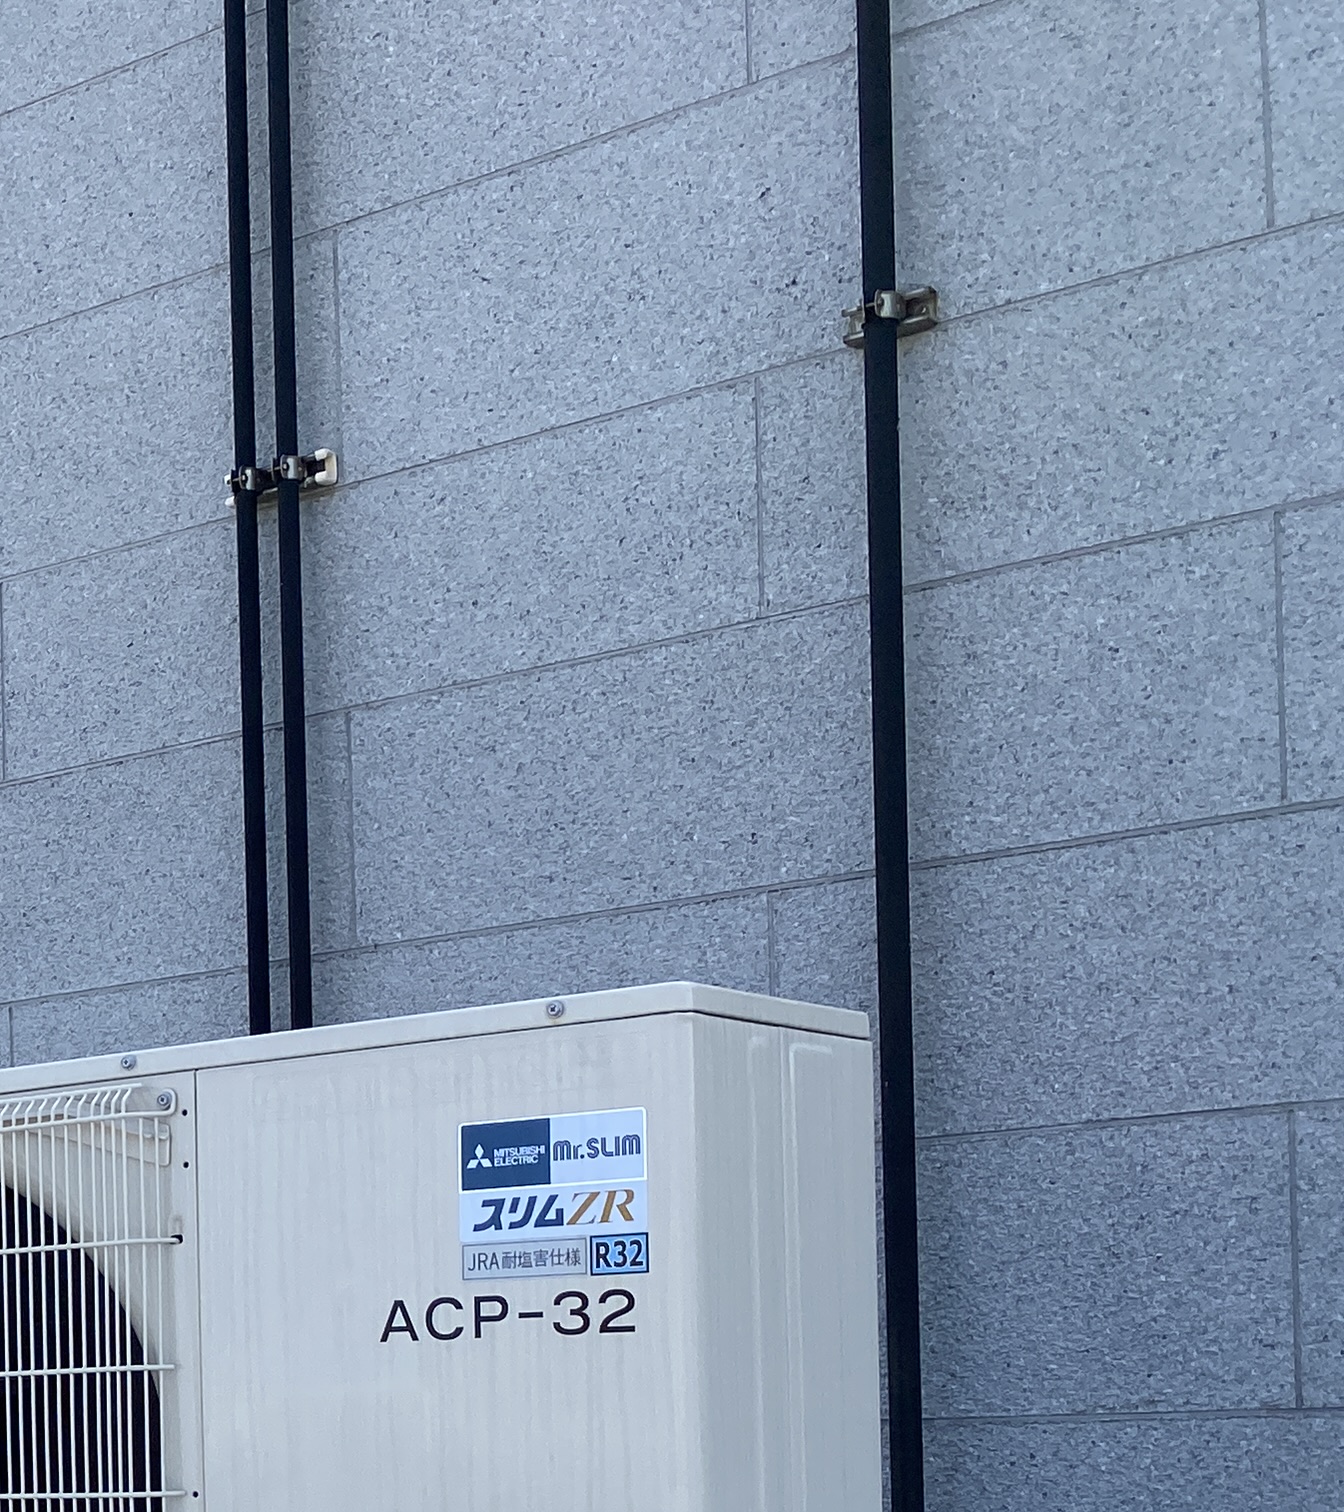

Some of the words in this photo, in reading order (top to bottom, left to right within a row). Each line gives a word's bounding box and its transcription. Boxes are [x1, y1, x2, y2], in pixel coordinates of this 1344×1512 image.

[494, 1145, 545, 1157] MITSUBISHI
[494, 1156, 539, 1167] ELECTRIC
[553, 1134, 641, 1161] Mr.SLIM
[472, 1189, 634, 1232] スリムZR
[595, 1239, 643, 1269] R32
[380, 1288, 636, 1343] ACP-32
